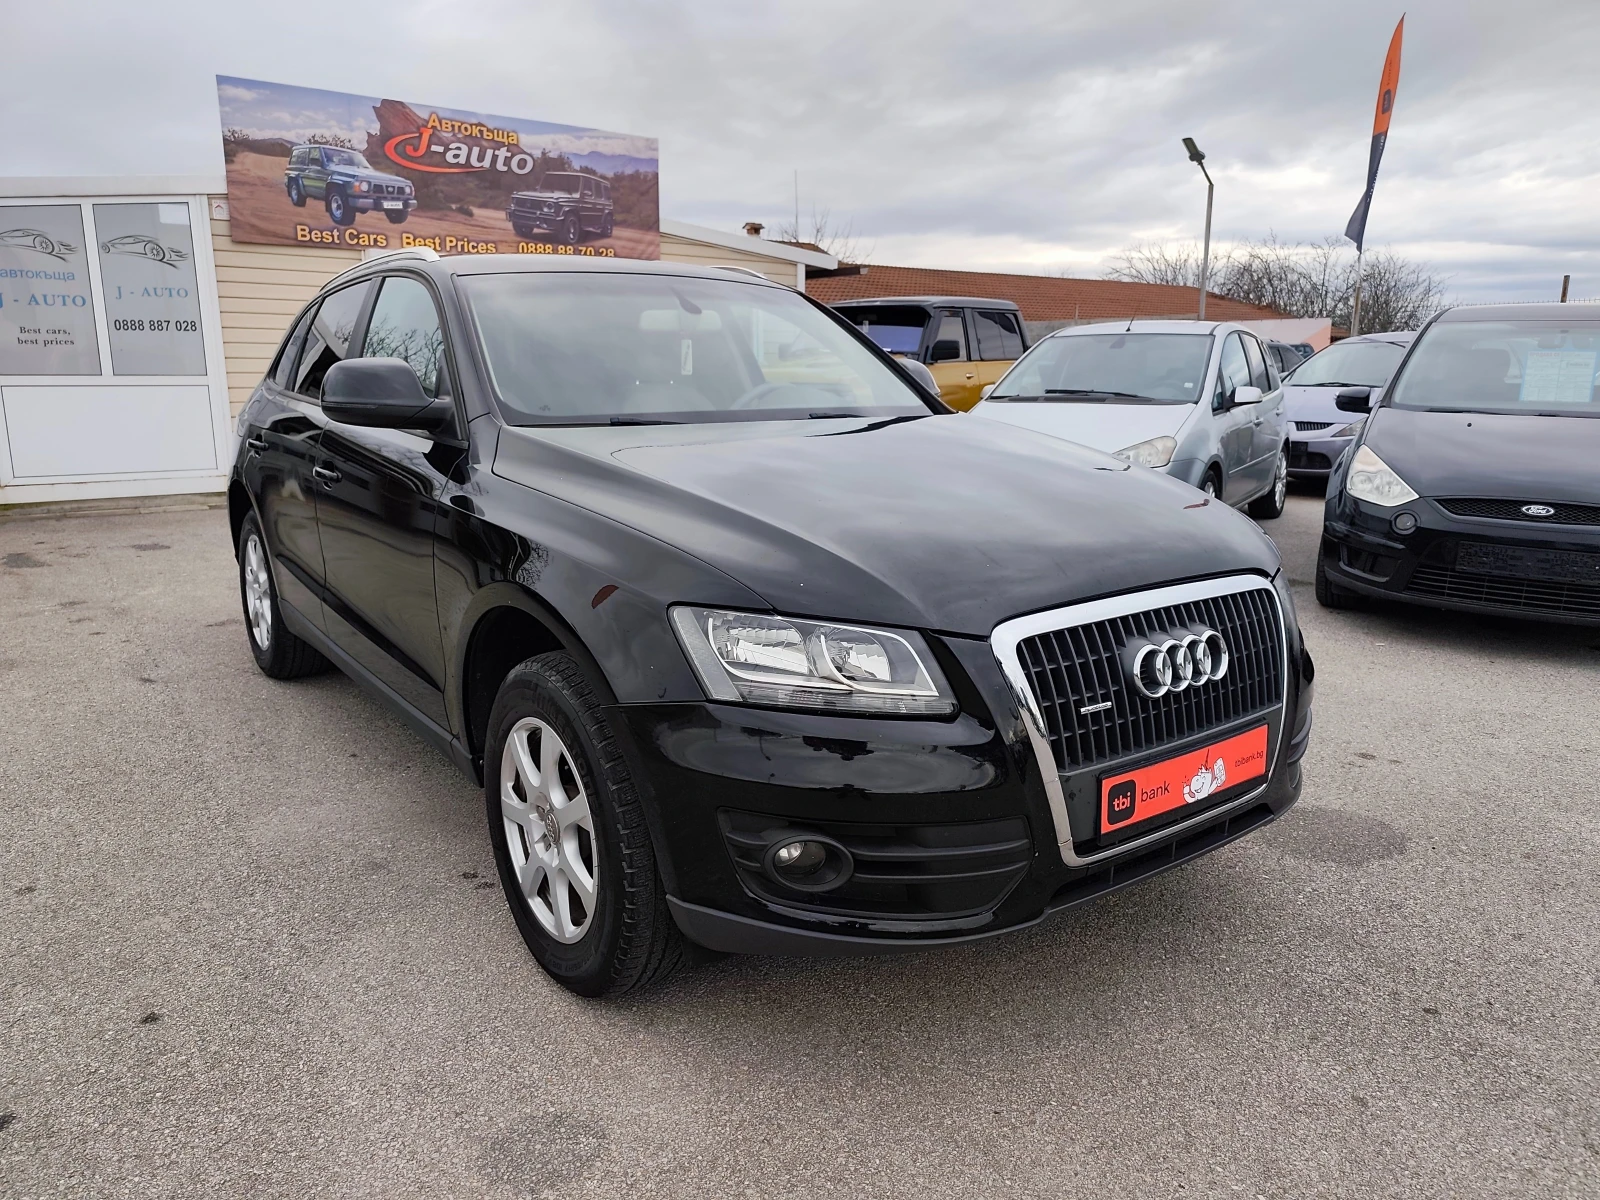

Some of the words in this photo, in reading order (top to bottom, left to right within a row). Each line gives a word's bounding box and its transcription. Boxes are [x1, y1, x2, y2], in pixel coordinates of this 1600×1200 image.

[427, 113, 519, 145] Автокъща
[405, 127, 534, 174] J-auto
[296, 224, 340, 243] Best
[344, 229, 387, 247] Cars
[402, 233, 441, 250] Best
[445, 236, 497, 254] Prices
[518, 242, 553, 254] 0888
[0, 268, 76, 282] автокъща
[27, 293, 87, 308] AUTO
[141, 287, 189, 299] AUTO
[19, 326, 41, 334] Best
[46, 328, 71, 336] cars,
[113, 319, 145, 331] 0888
[148, 320, 171, 332] 887
[175, 320, 197, 332] 028
[17, 337, 38, 345] best
[43, 338, 75, 347] prices
[1234, 750, 1264, 767] tbibank.bg
[1140, 781, 1171, 803] bank
[1112, 791, 1131, 811] tbi
